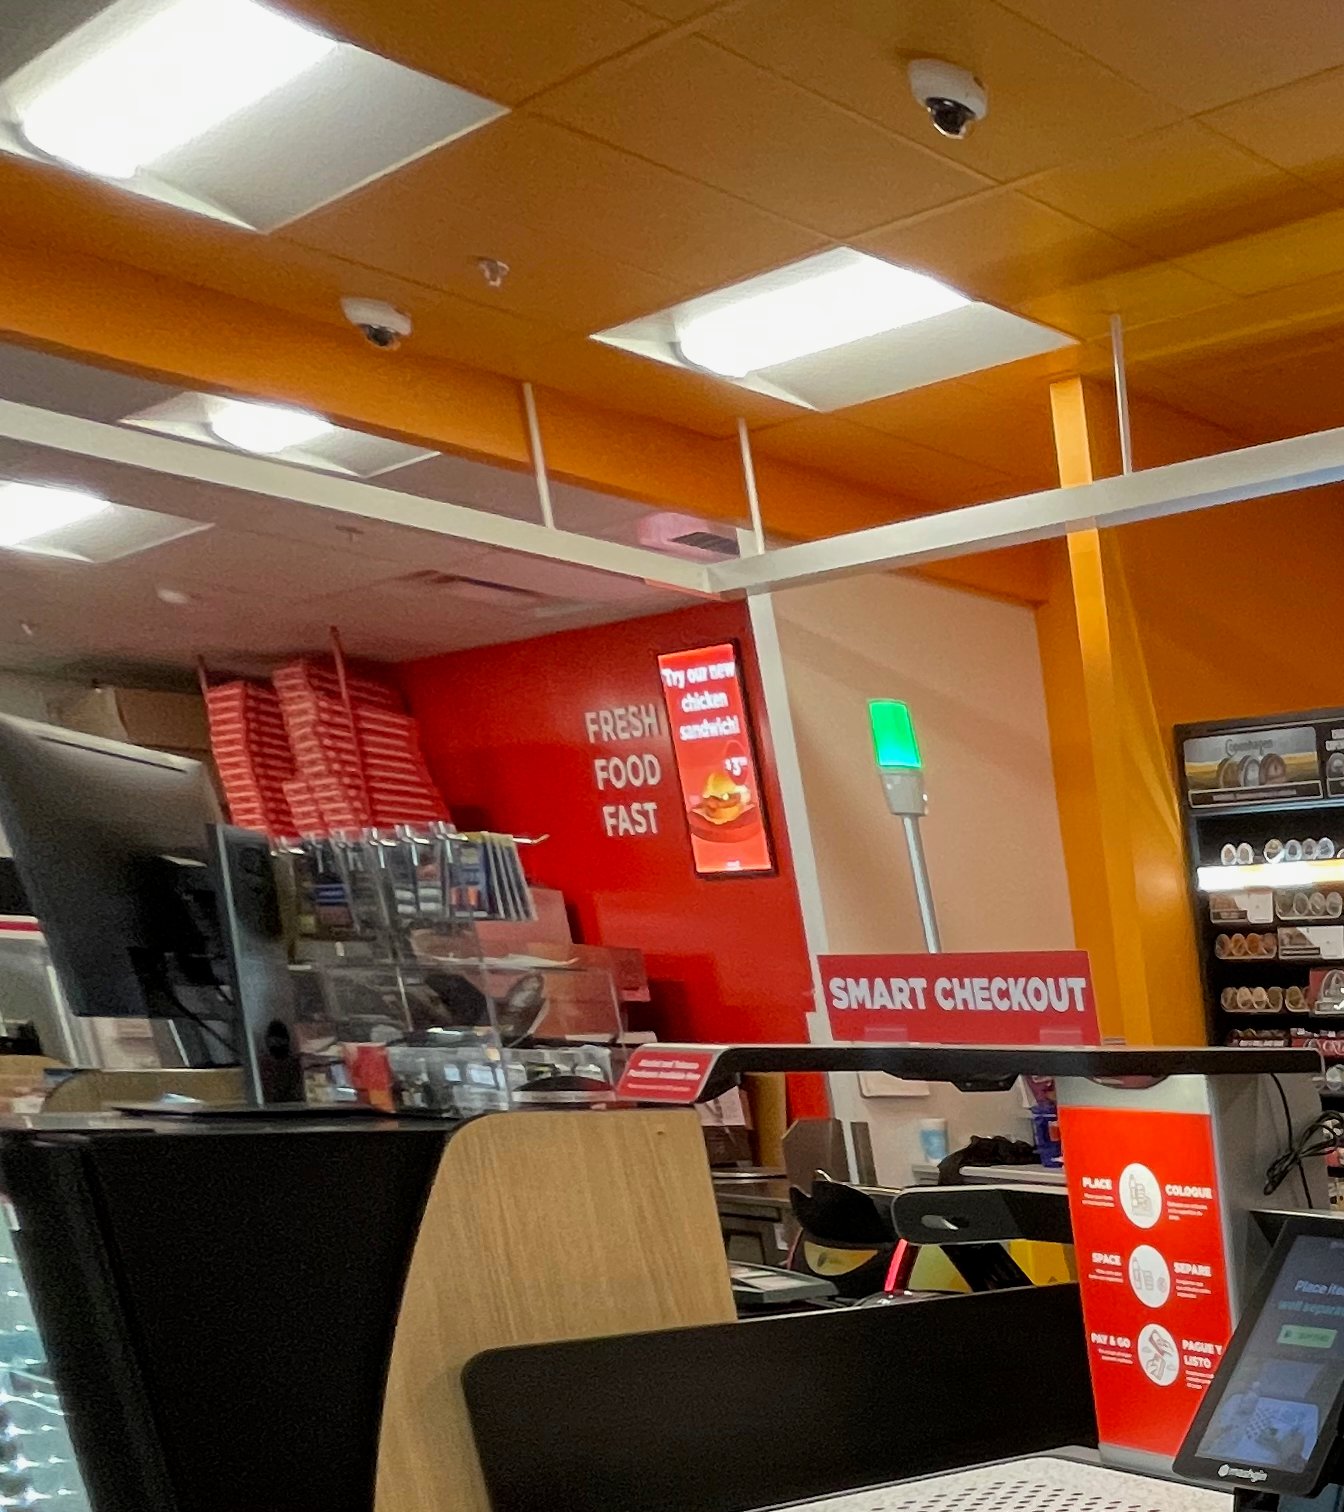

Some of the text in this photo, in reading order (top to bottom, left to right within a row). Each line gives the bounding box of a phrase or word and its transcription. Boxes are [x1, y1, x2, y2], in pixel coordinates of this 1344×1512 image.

[661, 666, 685, 689] Try
[687, 665, 708, 684] our
[680, 690, 729, 713] chicken
[584, 703, 662, 744] FRESH
[593, 753, 662, 791] FOOD
[602, 801, 658, 837] FAST
[829, 976, 1087, 1013] SMART CHECKOUT
[1294, 1279, 1328, 1295] Place
